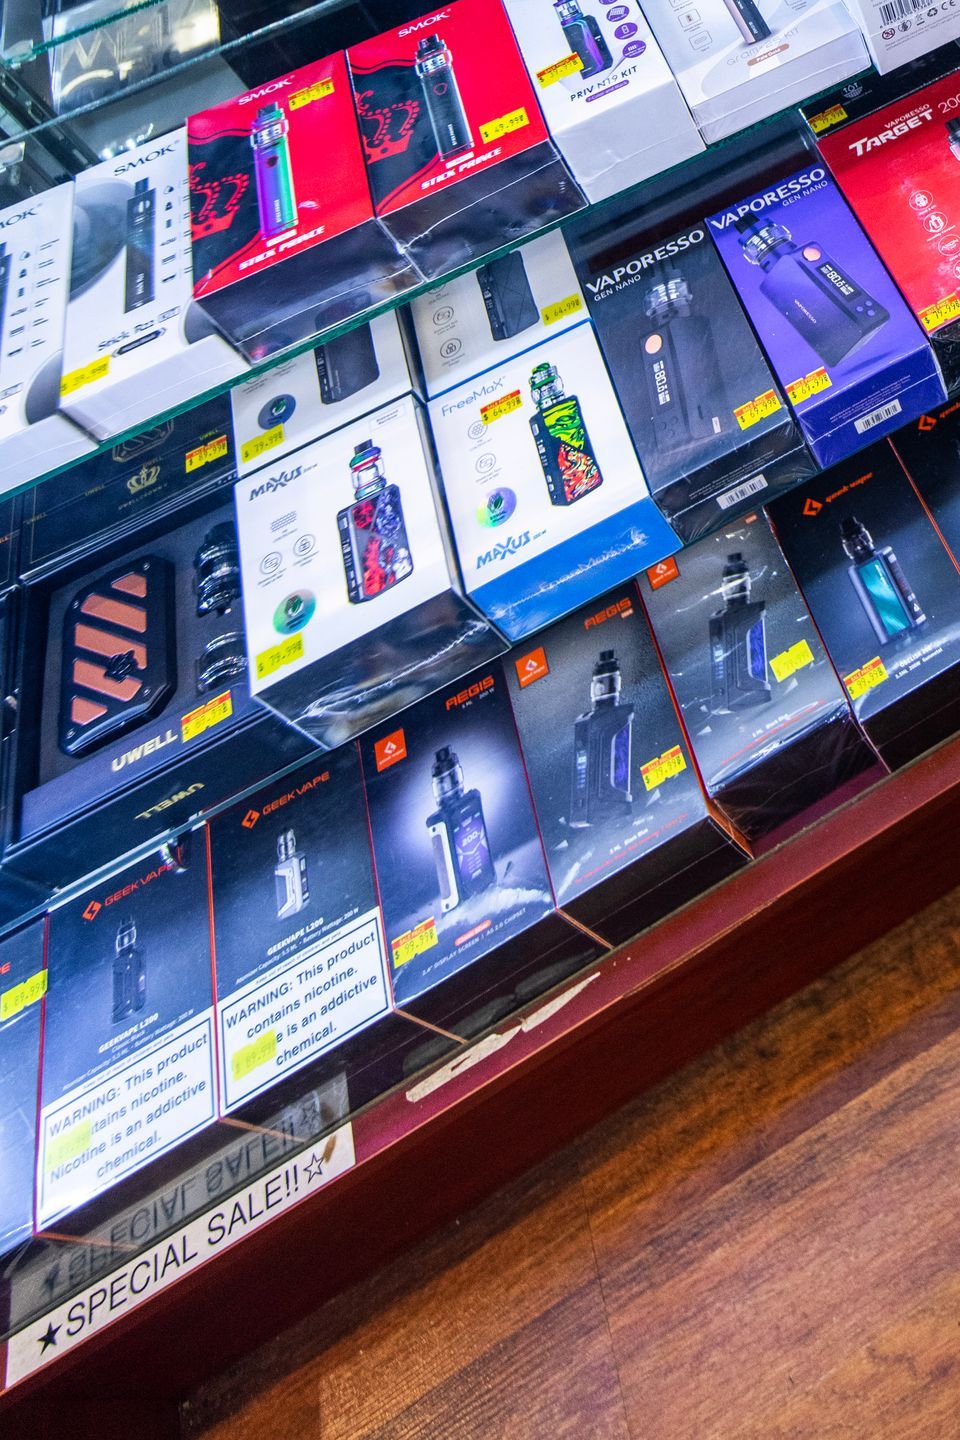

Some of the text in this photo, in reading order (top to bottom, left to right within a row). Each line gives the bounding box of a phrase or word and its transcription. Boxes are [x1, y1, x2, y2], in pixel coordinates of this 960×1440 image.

[398, 10, 449, 38] SMOK
[238, 77, 293, 106] SMOK
[569, 65, 638, 102] PRIV N19 KIT
[848, 108, 934, 158] TARGET
[884, 103, 930, 130] VAPORESSO
[113, 144, 176, 177] SMOK
[420, 146, 503, 191] STICK PRINCE
[710, 167, 826, 231] VAPORESSO
[782, 179, 829, 208] GEN NANO
[238, 225, 326, 272] STICK PRINCE
[584, 228, 705, 295] VAPORESSO
[593, 273, 642, 303] GEN NANO
[584, 596, 633, 632] AEGIS
[445, 674, 496, 712] AEGIS
[111, 729, 179, 773] UWELL
[267, 917, 325, 957] GEEKVAPE L200
[225, 931, 376, 1030] WARNING: This product
[247, 966, 359, 1040] contains nicotine.
[286, 974, 378, 1039] is an addictive
[98, 1022, 139, 1054] GEEKVAPE
[275, 1020, 338, 1068] chemical.
[49, 1033, 208, 1138] WARNING: This product
[131, 1071, 188, 1112] nicotine.
[50, 1141, 106, 1182] Nicotine
[111, 1130, 122, 1147] is
[126, 1117, 142, 1137] an
[146, 1079, 206, 1125] addictive
[96, 1130, 162, 1179] chemical.
[66, 1164, 299, 1337] SPECIAL SALE!!
